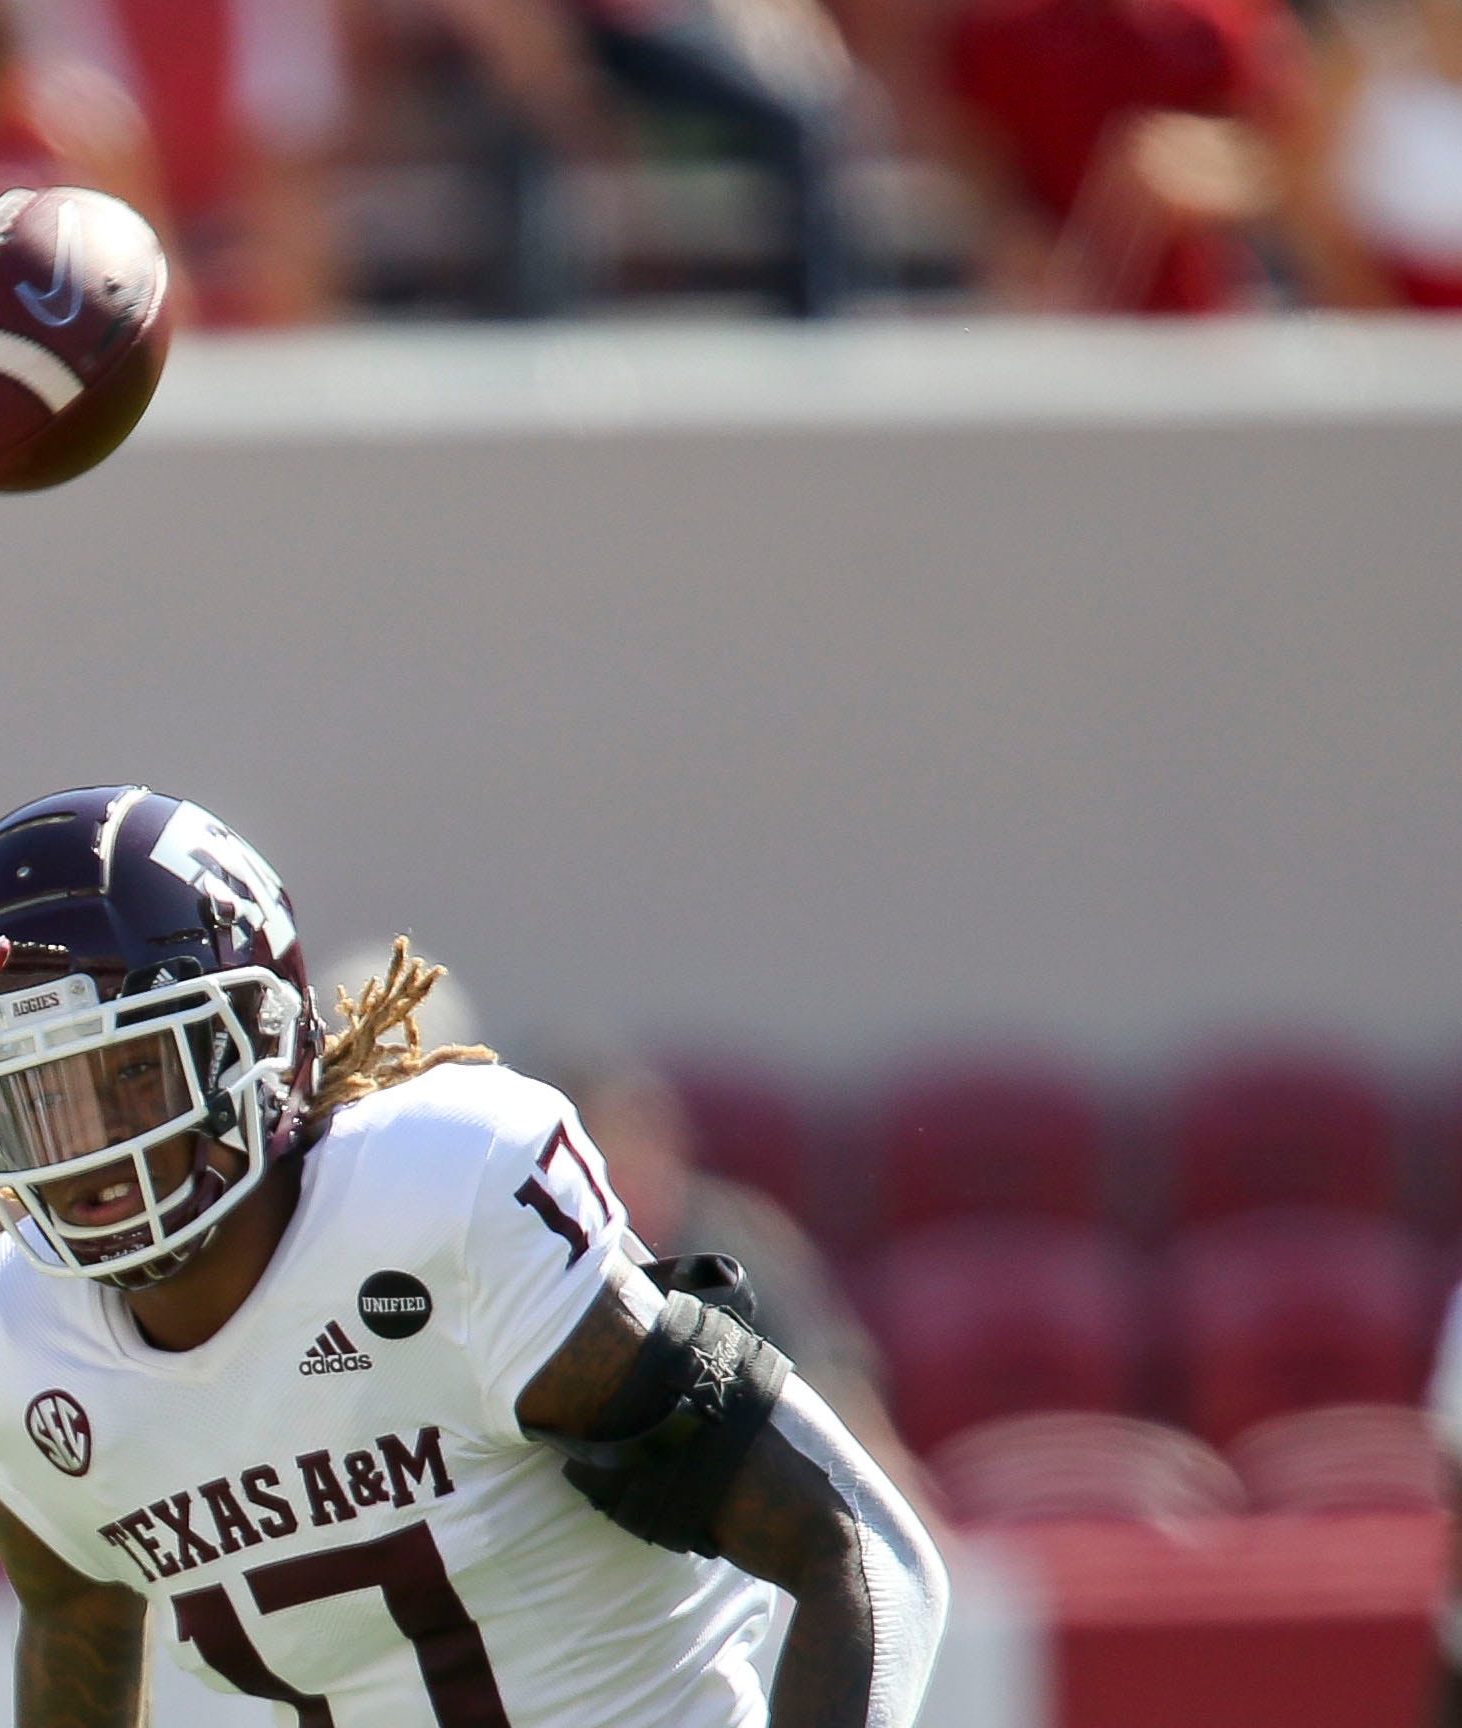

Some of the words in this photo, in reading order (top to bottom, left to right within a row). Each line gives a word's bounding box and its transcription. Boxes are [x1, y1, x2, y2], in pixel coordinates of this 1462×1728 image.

[11, 991, 60, 1018] AGGIES
[515, 1121, 614, 1270] 17
[361, 1293, 427, 1314] UNIFIED
[298, 1348, 373, 1375] adidas
[28, 1404, 90, 1466] SEC
[97, 1463, 299, 1582] TEXAS
[295, 1425, 456, 1528] A&M
